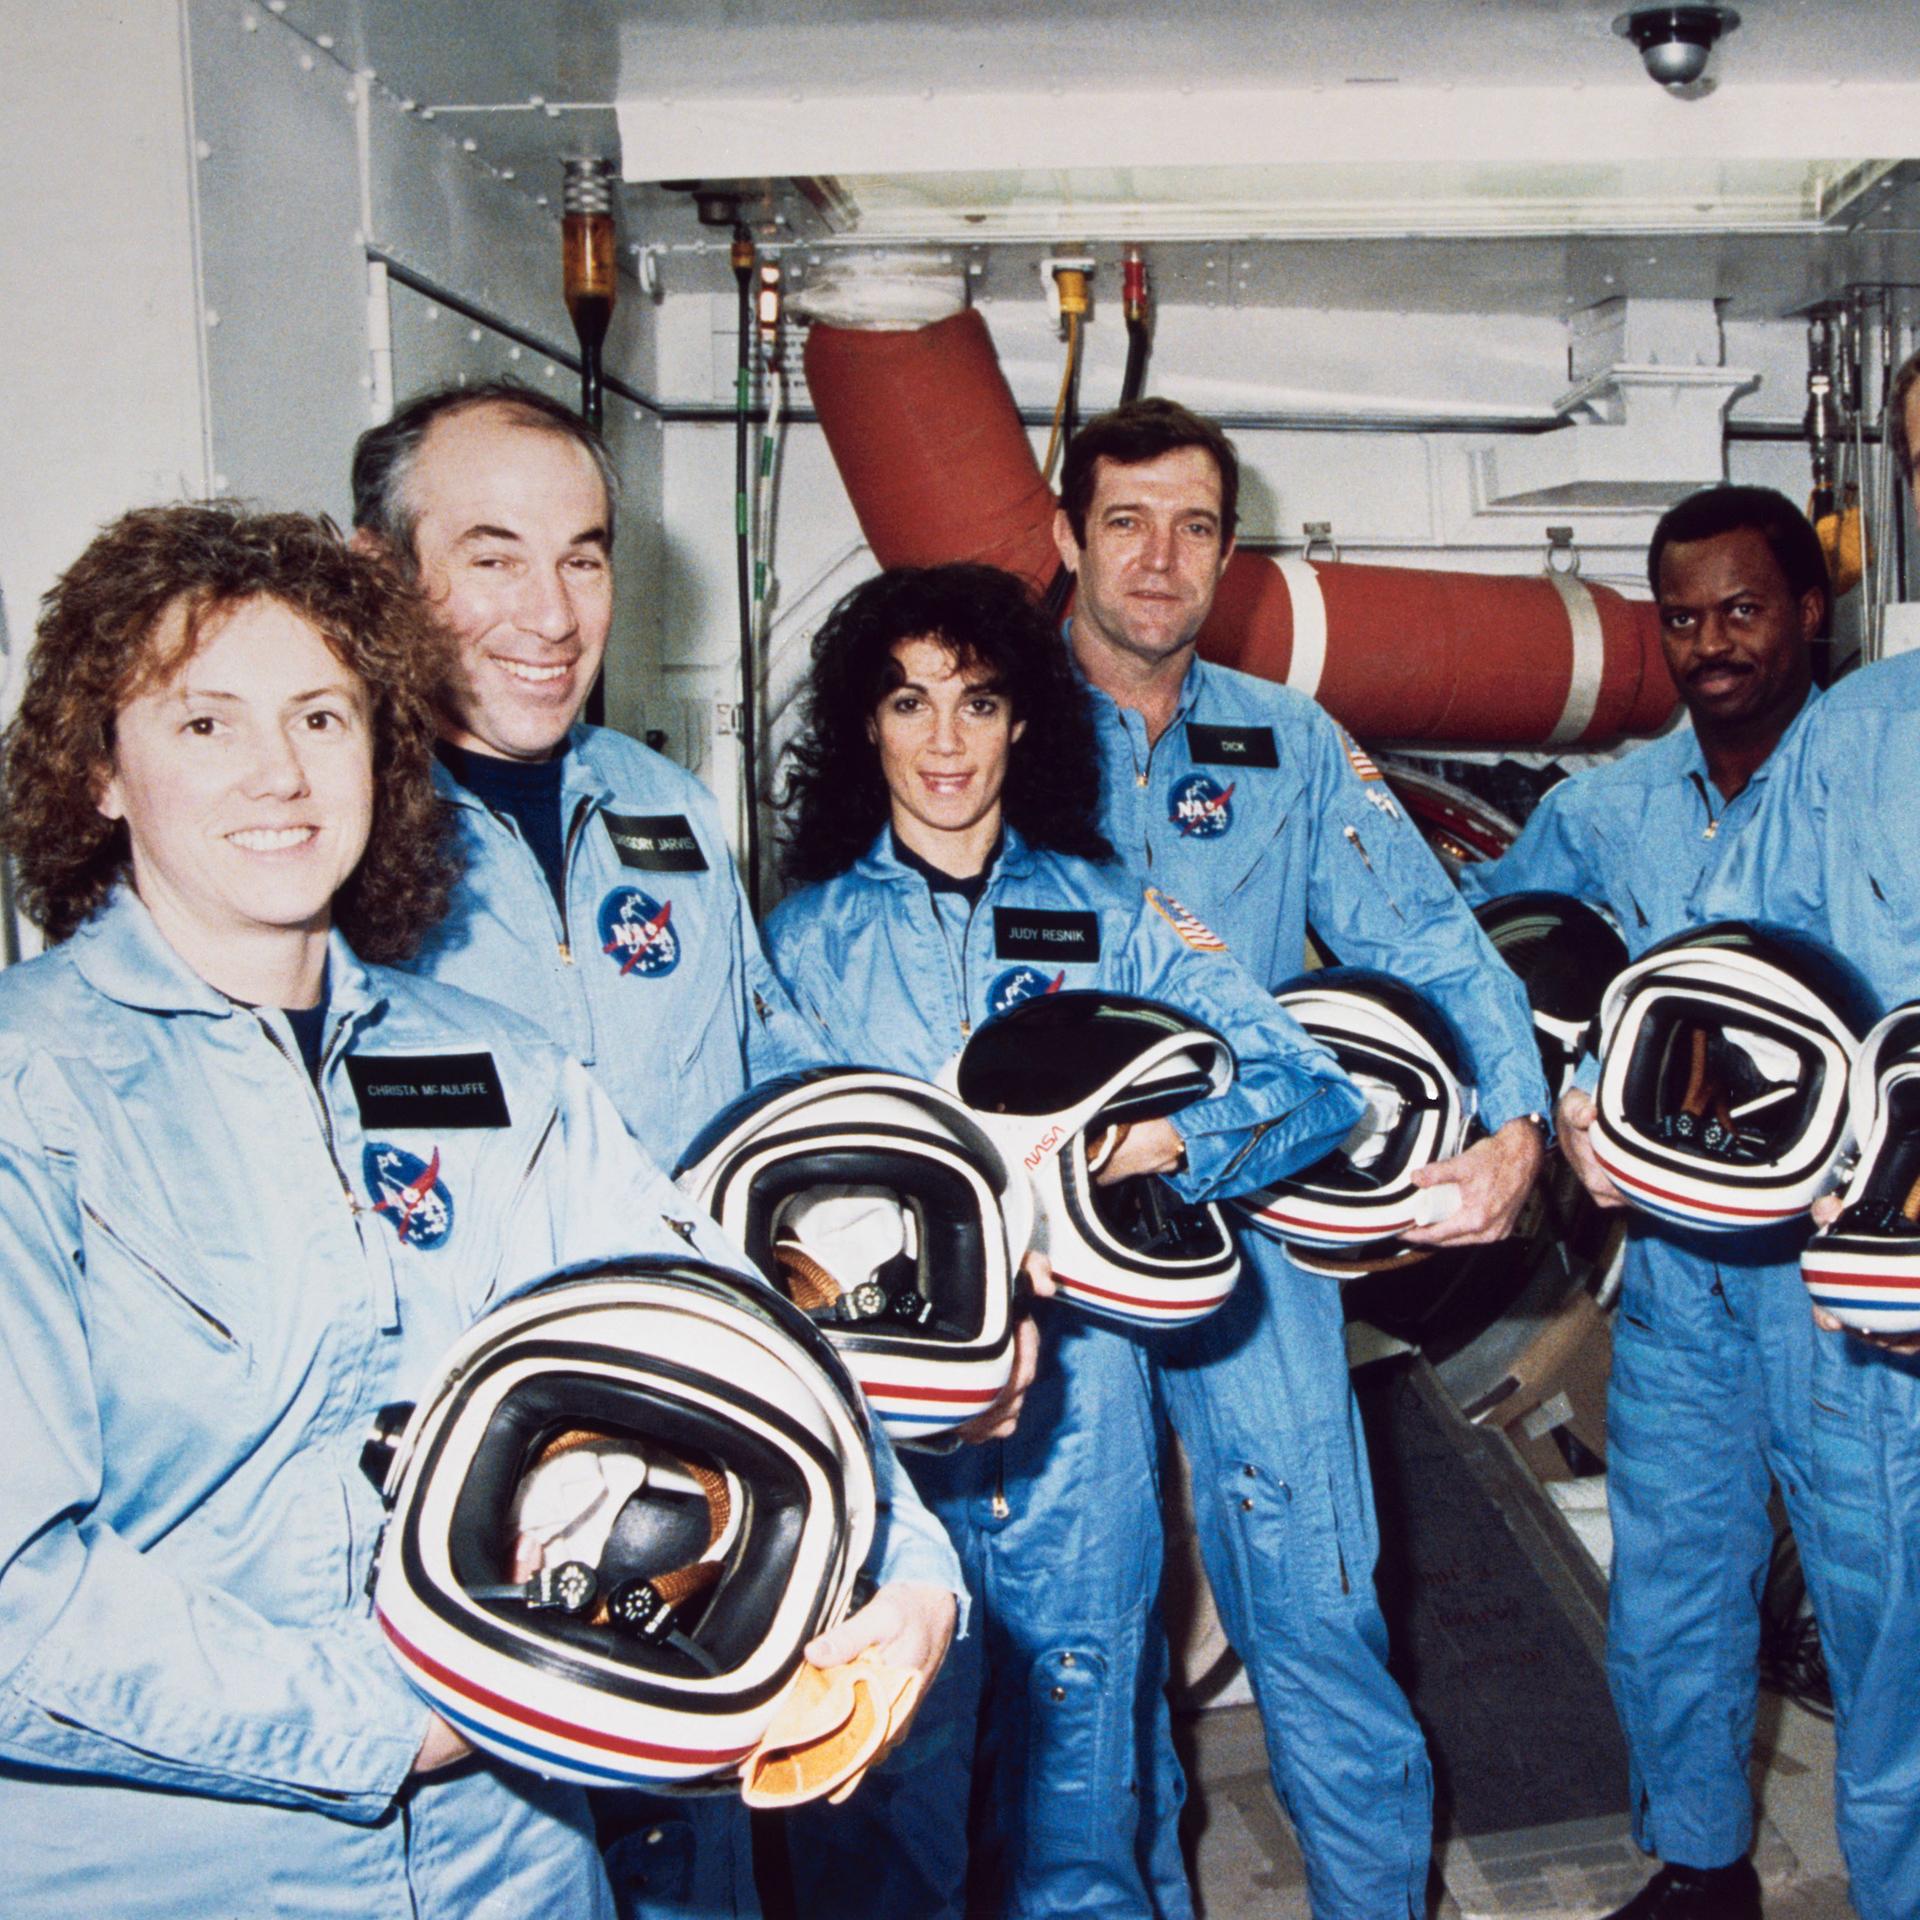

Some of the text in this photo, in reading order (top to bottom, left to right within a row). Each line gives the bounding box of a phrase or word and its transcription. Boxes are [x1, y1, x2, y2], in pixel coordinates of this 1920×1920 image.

[1221, 741, 1246, 752] DICK
[610, 831, 697, 852] GORY JARVIS
[1009, 927, 1086, 942] JUDY RESNIK
[367, 1084, 418, 1097] CHRISTA
[1024, 1125, 1066, 1171] NASA
